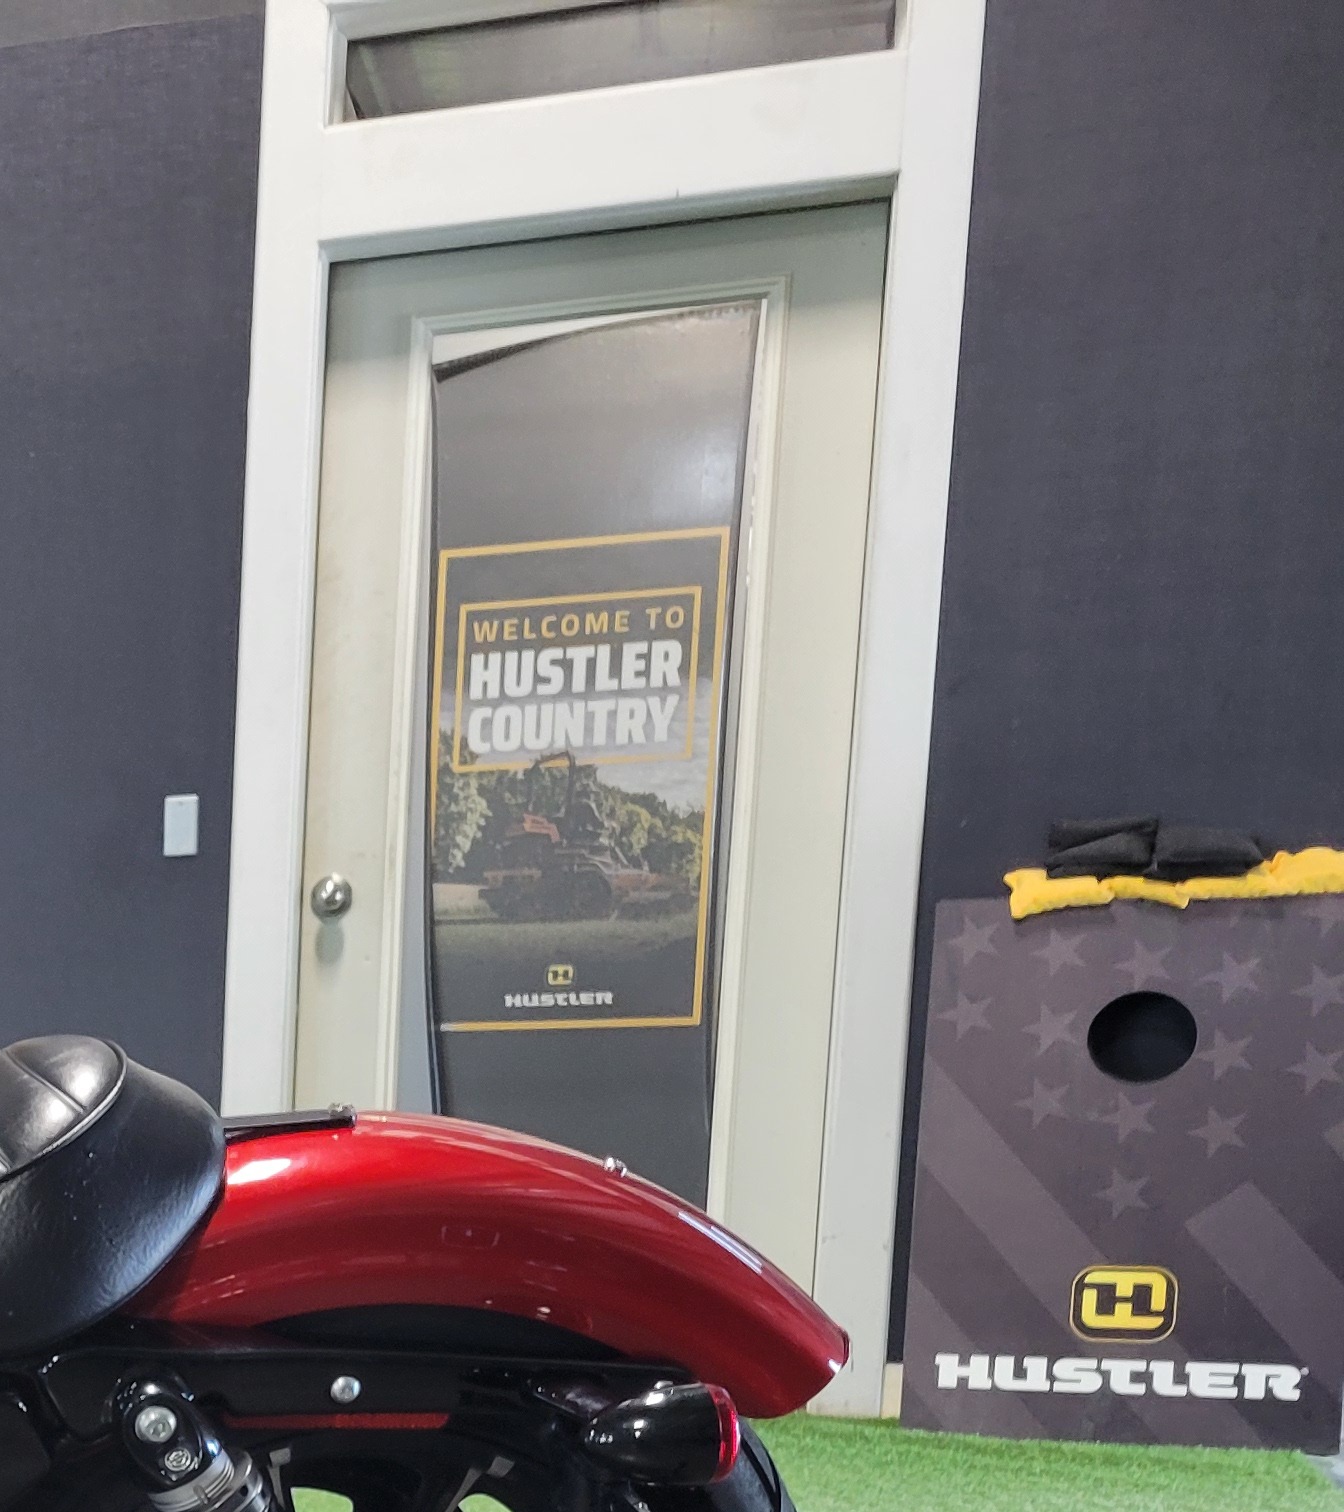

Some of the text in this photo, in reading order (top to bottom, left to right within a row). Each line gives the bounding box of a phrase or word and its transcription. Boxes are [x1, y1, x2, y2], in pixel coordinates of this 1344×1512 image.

[473, 606, 684, 643] WELCOME TO
[469, 639, 683, 701] HUSTLER
[467, 694, 680, 753] COUNTRY
[504, 992, 613, 1008] HUSTLER
[935, 1354, 1302, 1401] HUSTLER
